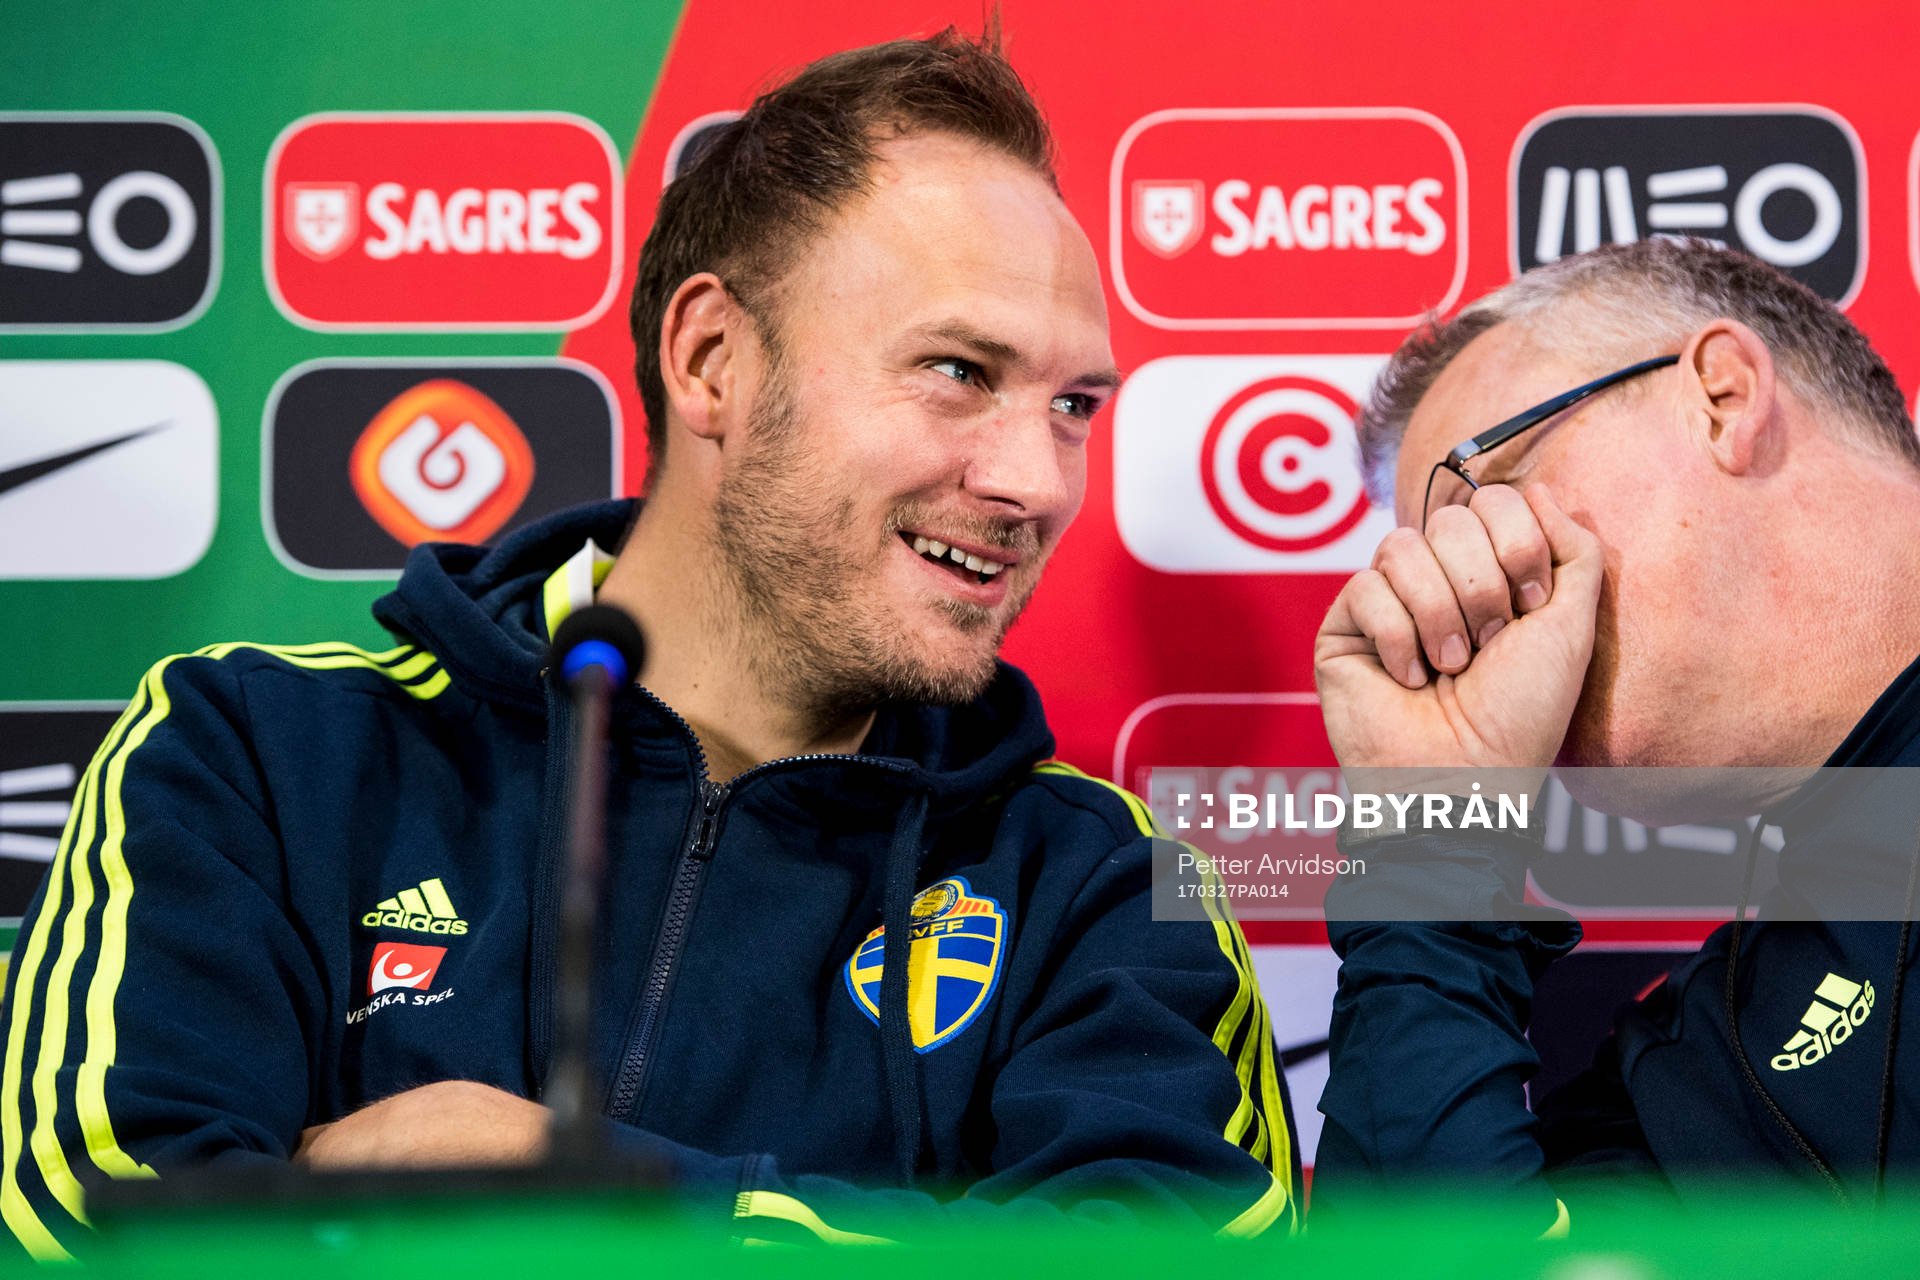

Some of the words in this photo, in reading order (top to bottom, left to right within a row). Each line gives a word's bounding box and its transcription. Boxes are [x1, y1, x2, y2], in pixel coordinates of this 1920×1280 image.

[0, 170, 197, 275] EO
[364, 181, 603, 260] SAGRES
[1211, 178, 1446, 257] SAGRES
[1215, 765, 1351, 843] SAG
[361, 909, 469, 935] adidas
[346, 992, 406, 1025] VENSKA
[412, 987, 455, 1006] SPEL
[1770, 979, 1875, 1071] adidas
